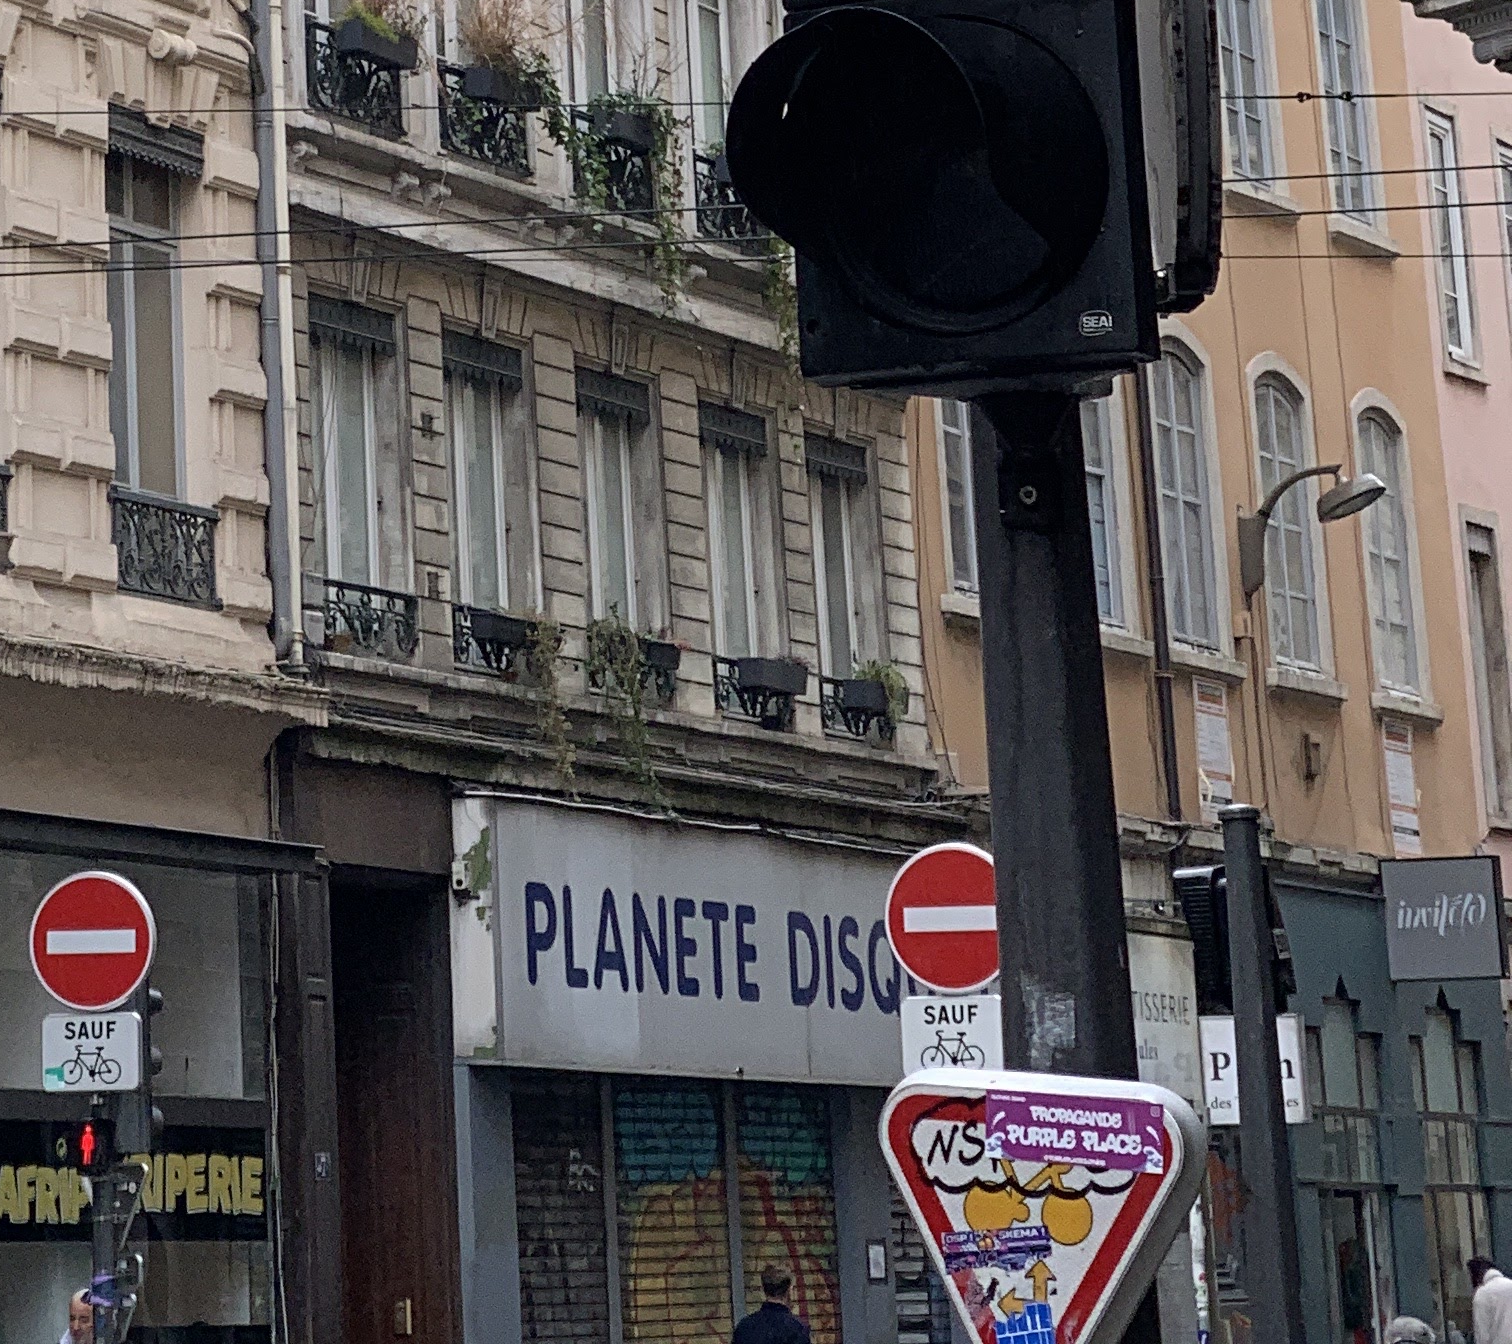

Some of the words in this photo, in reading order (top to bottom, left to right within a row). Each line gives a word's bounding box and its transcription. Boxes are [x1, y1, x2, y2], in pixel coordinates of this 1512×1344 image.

[525, 882, 760, 1002] PLANETE
[787, 911, 923, 1018] DISQ
[924, 1004, 979, 1025] SAUF
[64, 1020, 117, 1040] SAUF
[1210, 1097, 1233, 1110] des
[1006, 1124, 1077, 1150] PURPLE
[1081, 1130, 1143, 1156] PLACE
